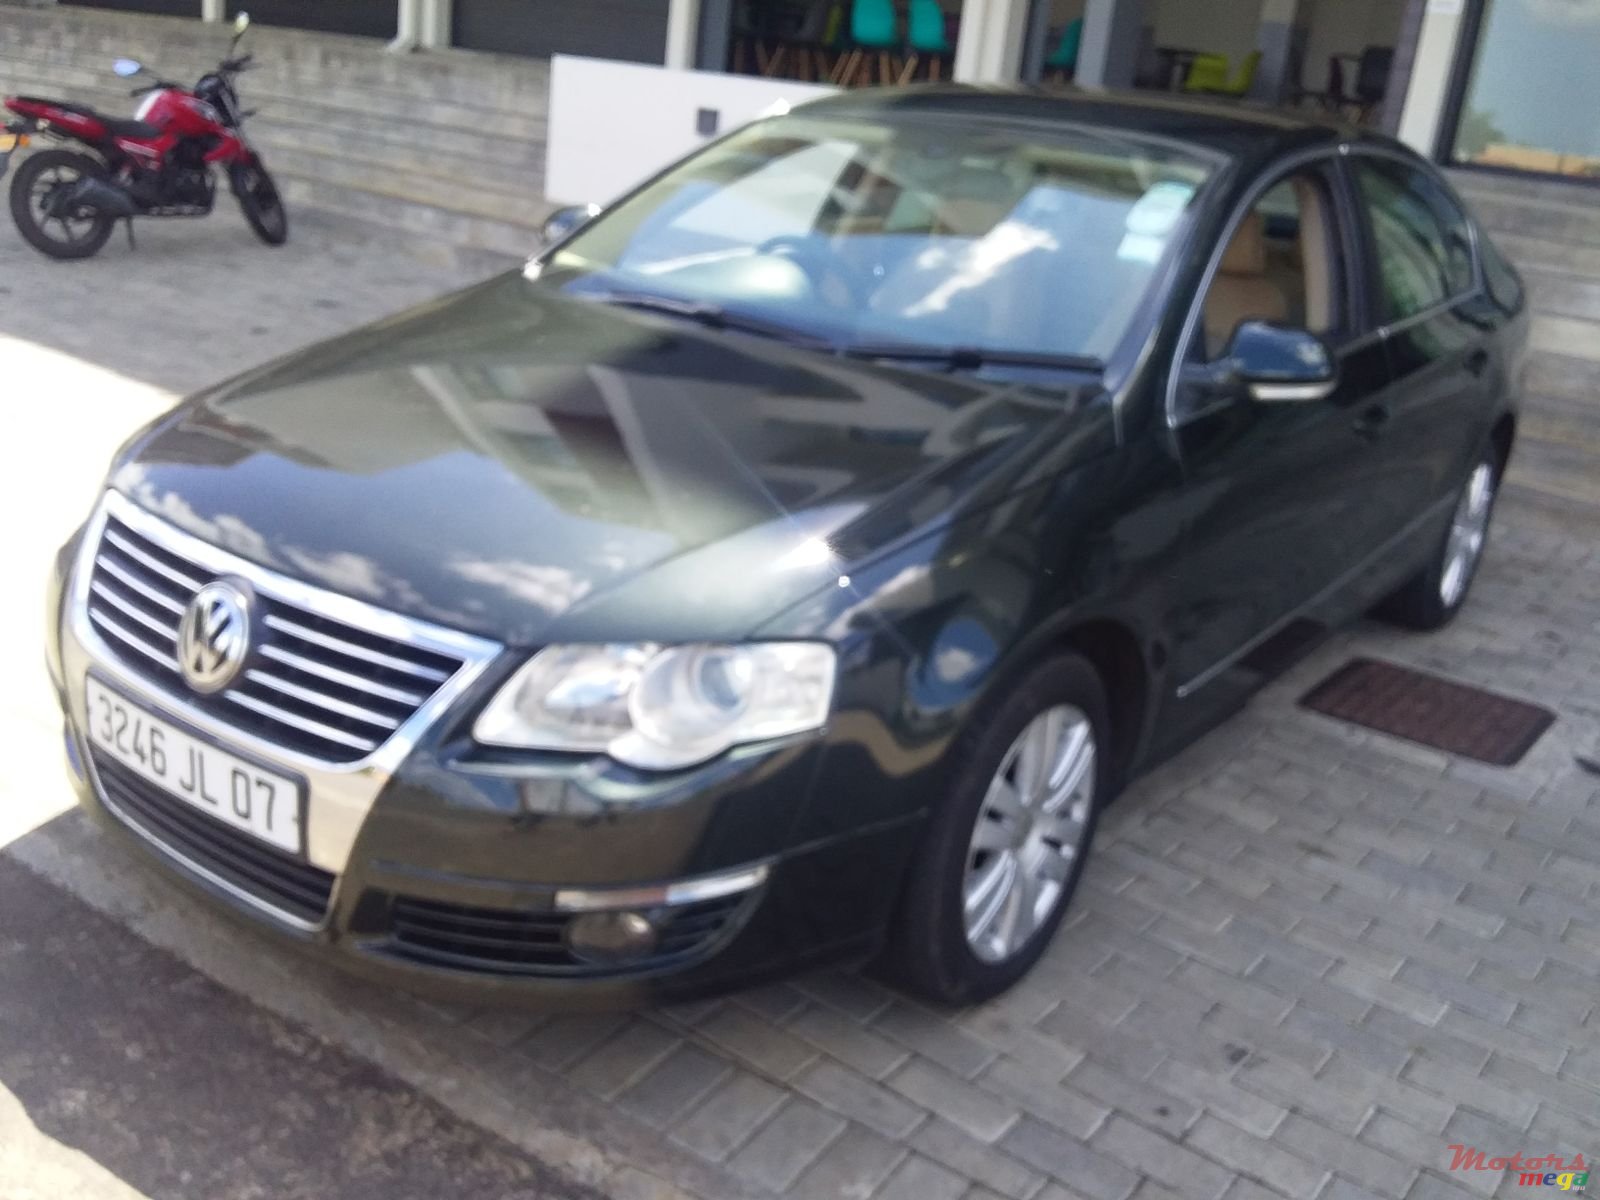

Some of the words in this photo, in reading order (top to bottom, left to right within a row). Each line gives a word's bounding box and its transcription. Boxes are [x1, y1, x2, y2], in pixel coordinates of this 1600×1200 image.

[98, 694, 167, 777] 3246
[179, 744, 218, 805] JL
[231, 766, 276, 831] 07
